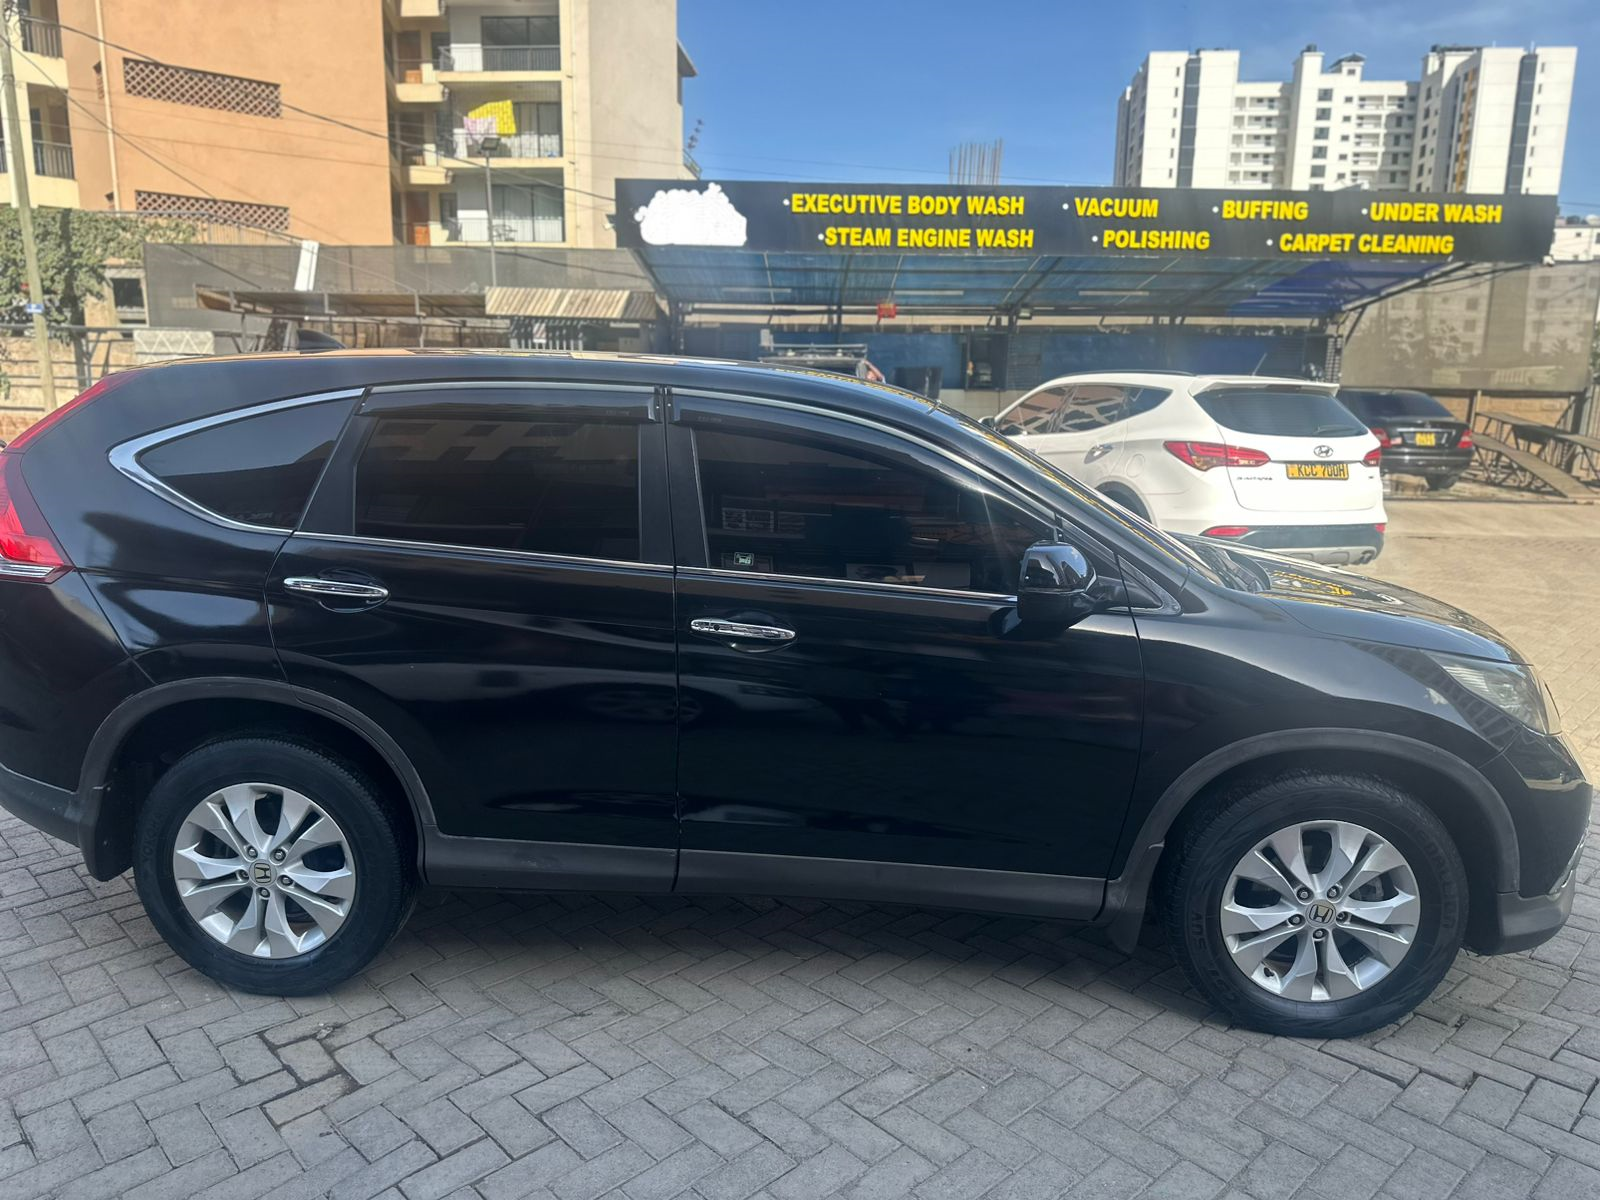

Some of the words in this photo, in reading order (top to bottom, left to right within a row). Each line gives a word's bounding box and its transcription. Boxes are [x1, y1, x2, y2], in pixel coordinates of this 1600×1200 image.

[791, 194, 902, 214] EXECUTIVE
[907, 196, 961, 215] BODY
[967, 197, 1024, 215] WASH
[1075, 199, 1159, 218] VACUUM
[1223, 200, 1309, 220] BUFFING
[1370, 202, 1440, 222] UNDER
[1443, 204, 1502, 224] WASH
[826, 227, 892, 247] STEAM
[897, 228, 971, 248] ENGINE
[976, 229, 1034, 248] WASH
[1104, 230, 1210, 250] POLISHING
[1280, 233, 1355, 253] CARPET
[1358, 234, 1455, 254] CLEANING
